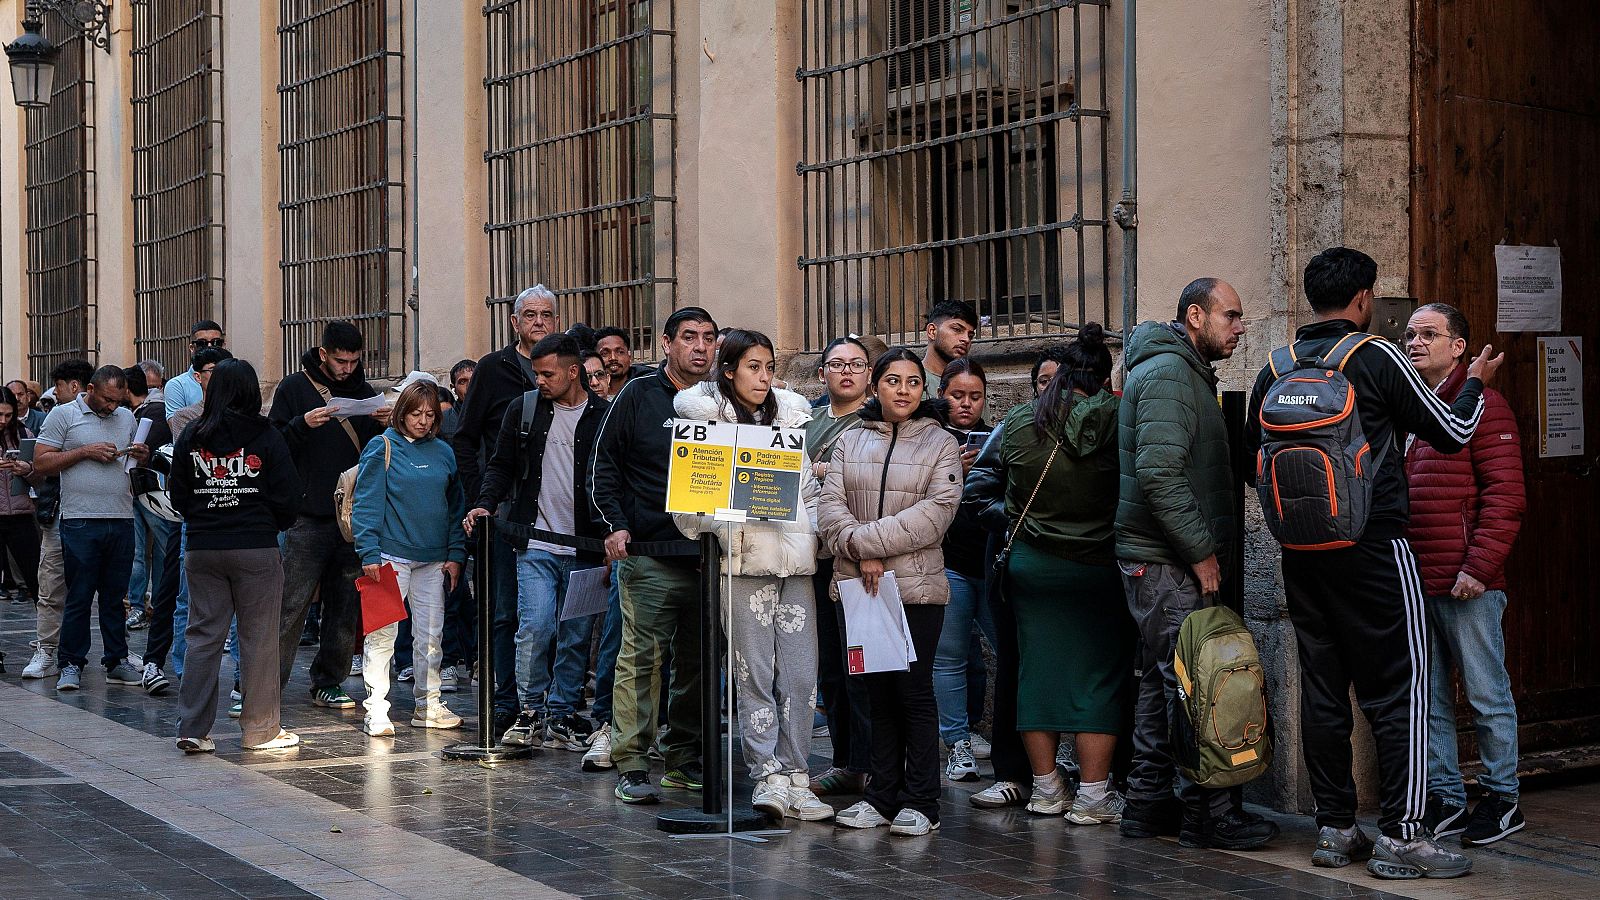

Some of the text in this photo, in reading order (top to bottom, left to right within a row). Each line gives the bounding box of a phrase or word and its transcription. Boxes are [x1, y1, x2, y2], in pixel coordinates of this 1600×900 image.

[694, 425, 707, 441] B
[770, 432, 785, 449] A
[692, 447, 723, 456] Atención
[757, 452, 781, 460] Padrón
[692, 454, 725, 463] Tributaria
[691, 471, 717, 480] Atenció
